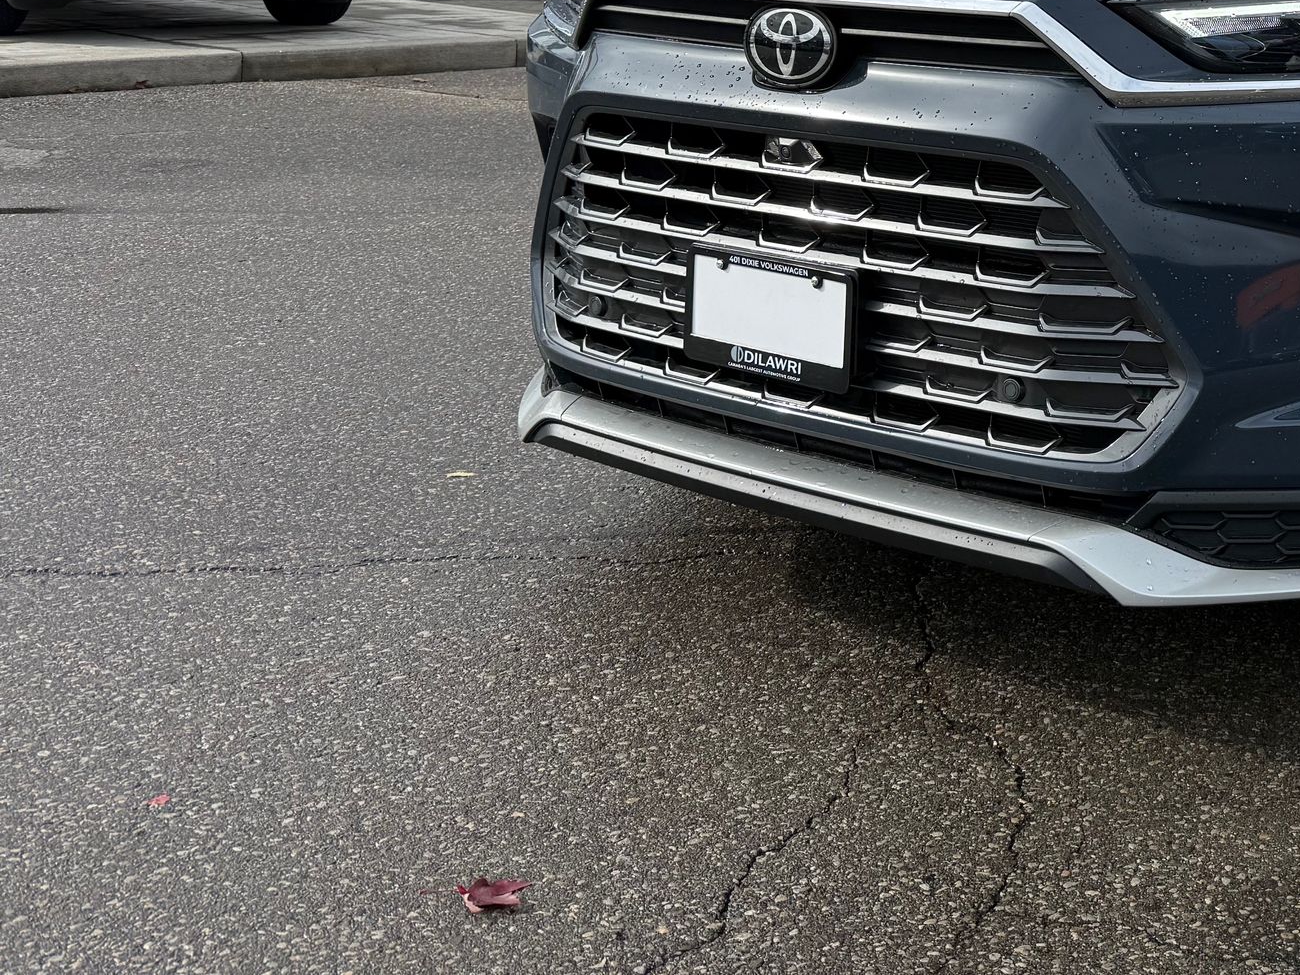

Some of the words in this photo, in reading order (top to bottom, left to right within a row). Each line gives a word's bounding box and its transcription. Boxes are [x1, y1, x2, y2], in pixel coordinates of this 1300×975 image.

[729, 256, 740, 264] 401
[741, 258, 759, 268] DIXIE
[760, 261, 809, 276] VOLKSWAGEN
[744, 351, 801, 375] DILAWRI
